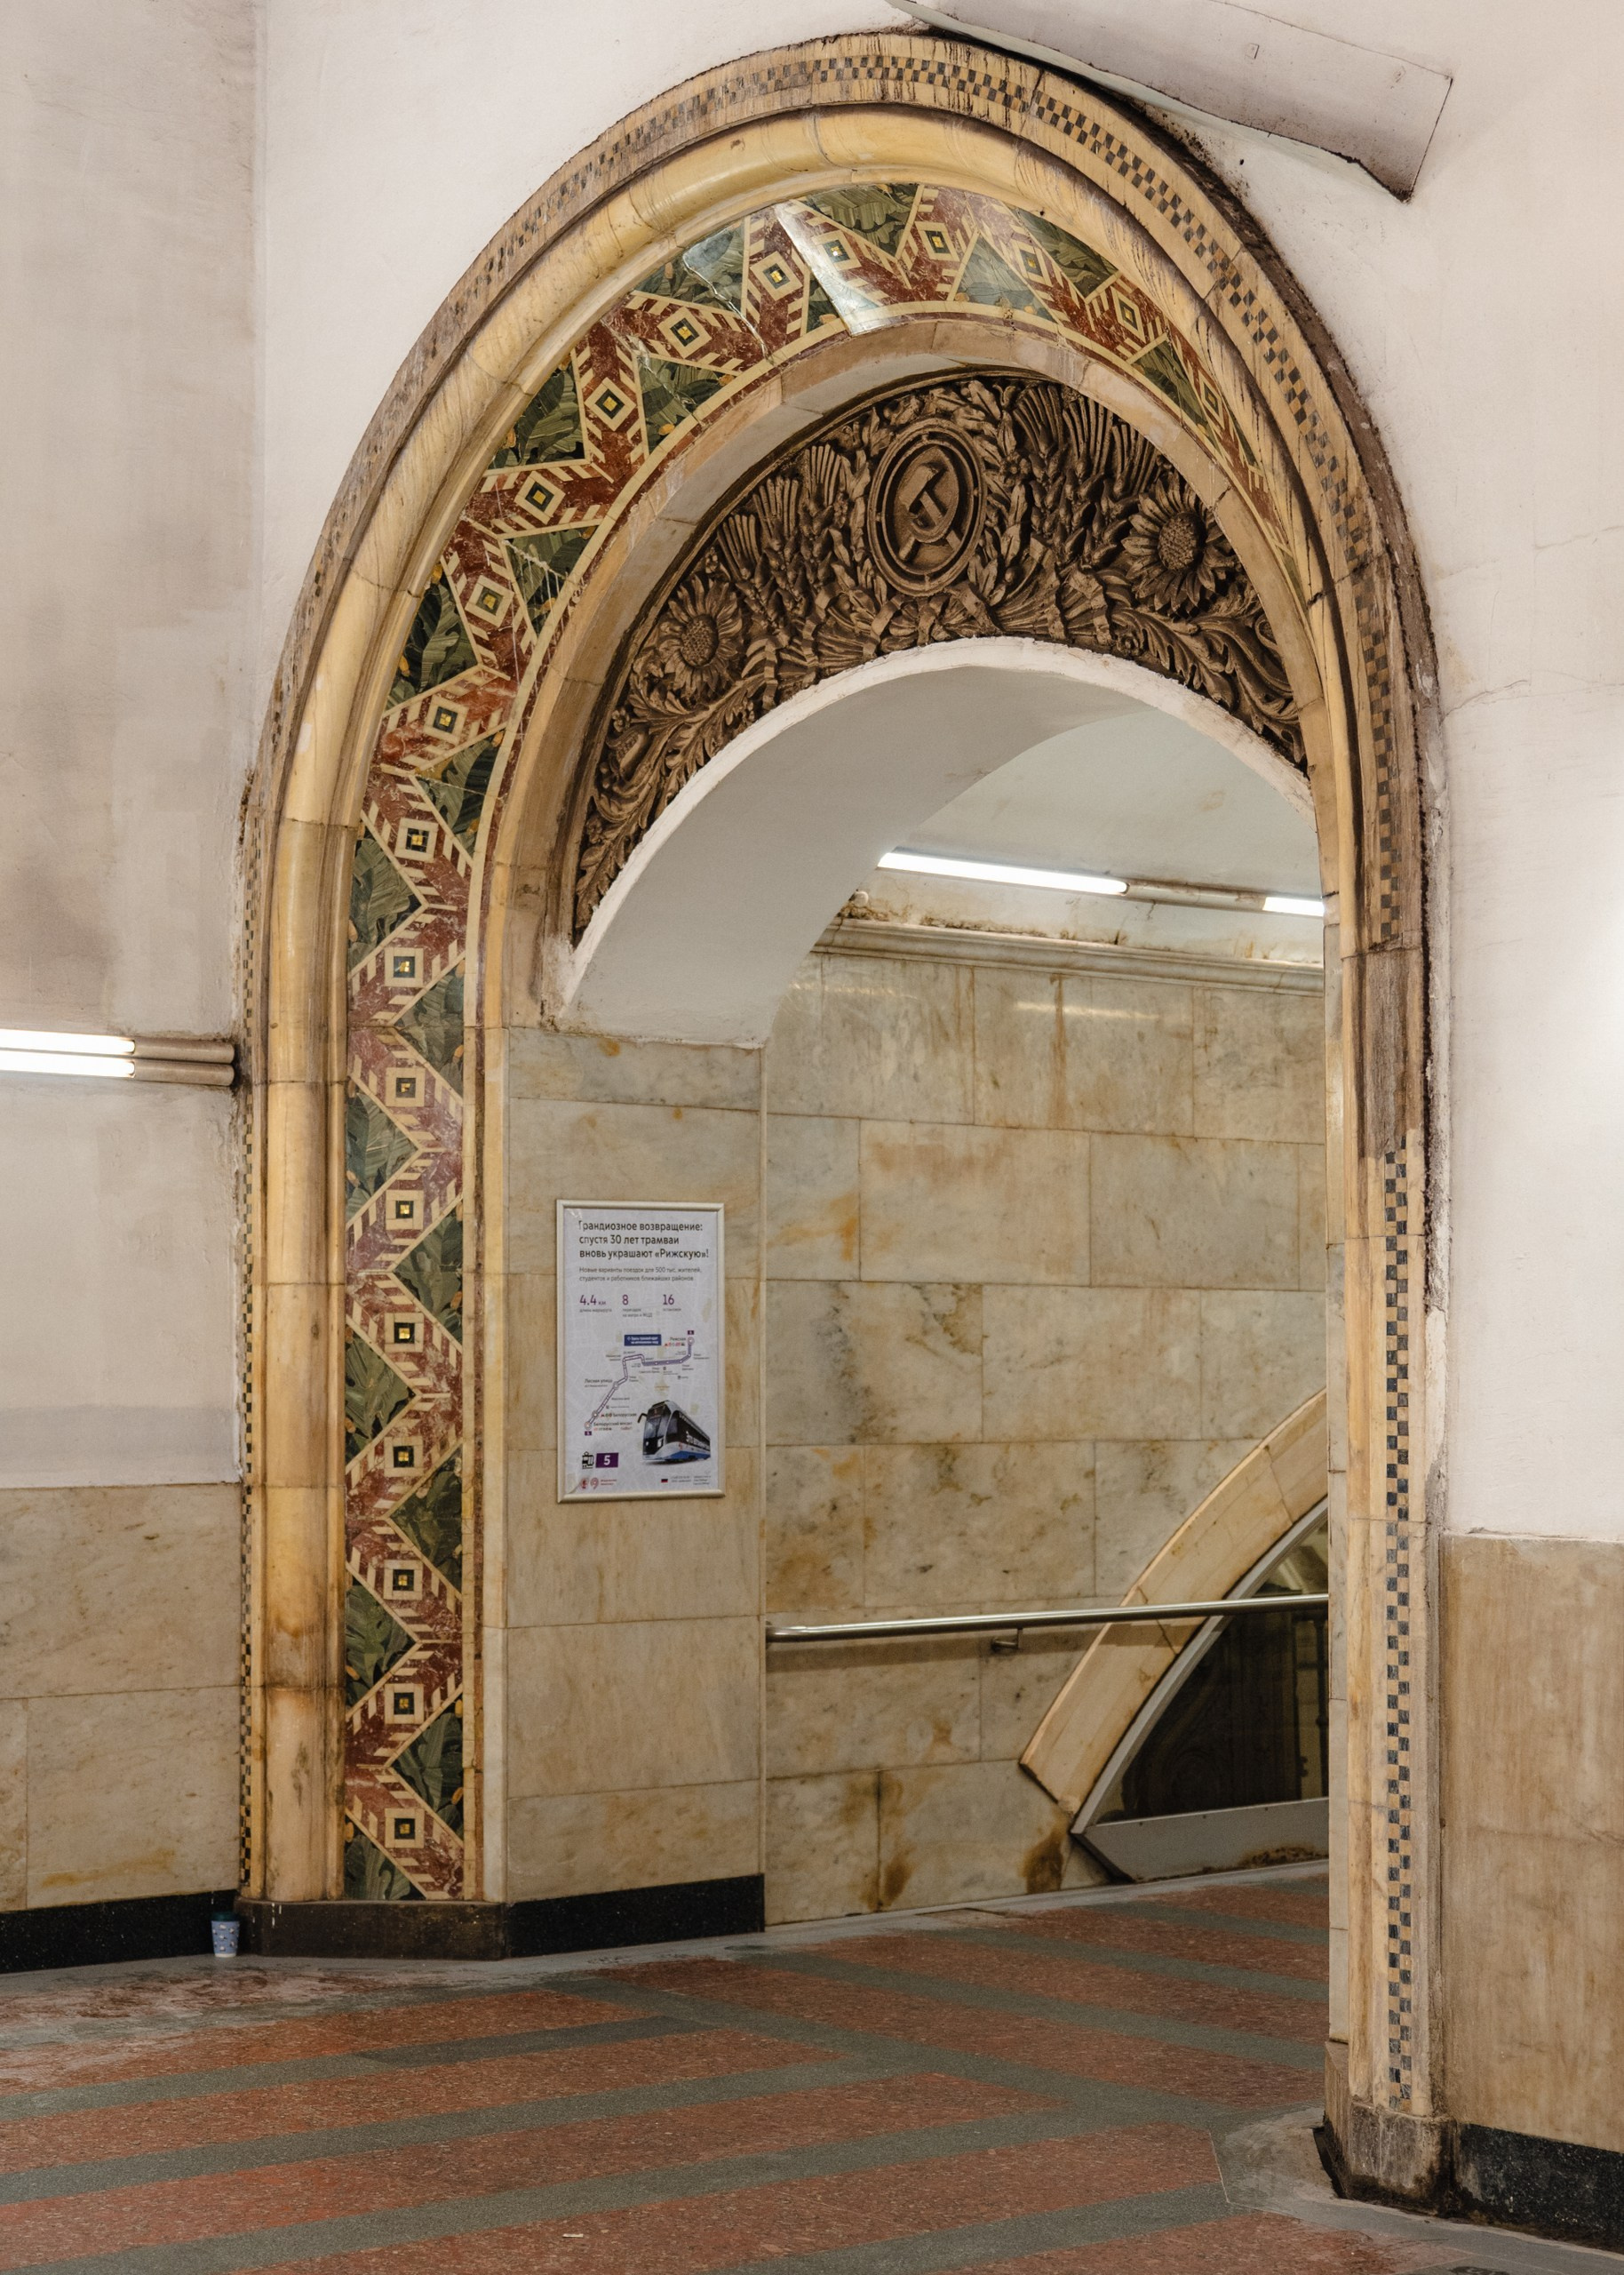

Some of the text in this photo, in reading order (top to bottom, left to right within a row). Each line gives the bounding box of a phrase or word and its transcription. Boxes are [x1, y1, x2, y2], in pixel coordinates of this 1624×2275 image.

[578, 1220, 703, 1232] Грандиозное возвращение:
[578, 1236, 608, 1245] спустя
[610, 1234, 622, 1244] 30
[641, 1236, 679, 1246] трамваи
[608, 1250, 652, 1260] украшают
[655, 1249, 709, 1260] «Рижскую»!
[622, 1294, 629, 1305] 8
[663, 1294, 674, 1305] 16
[603, 1455, 611, 1465] 5
